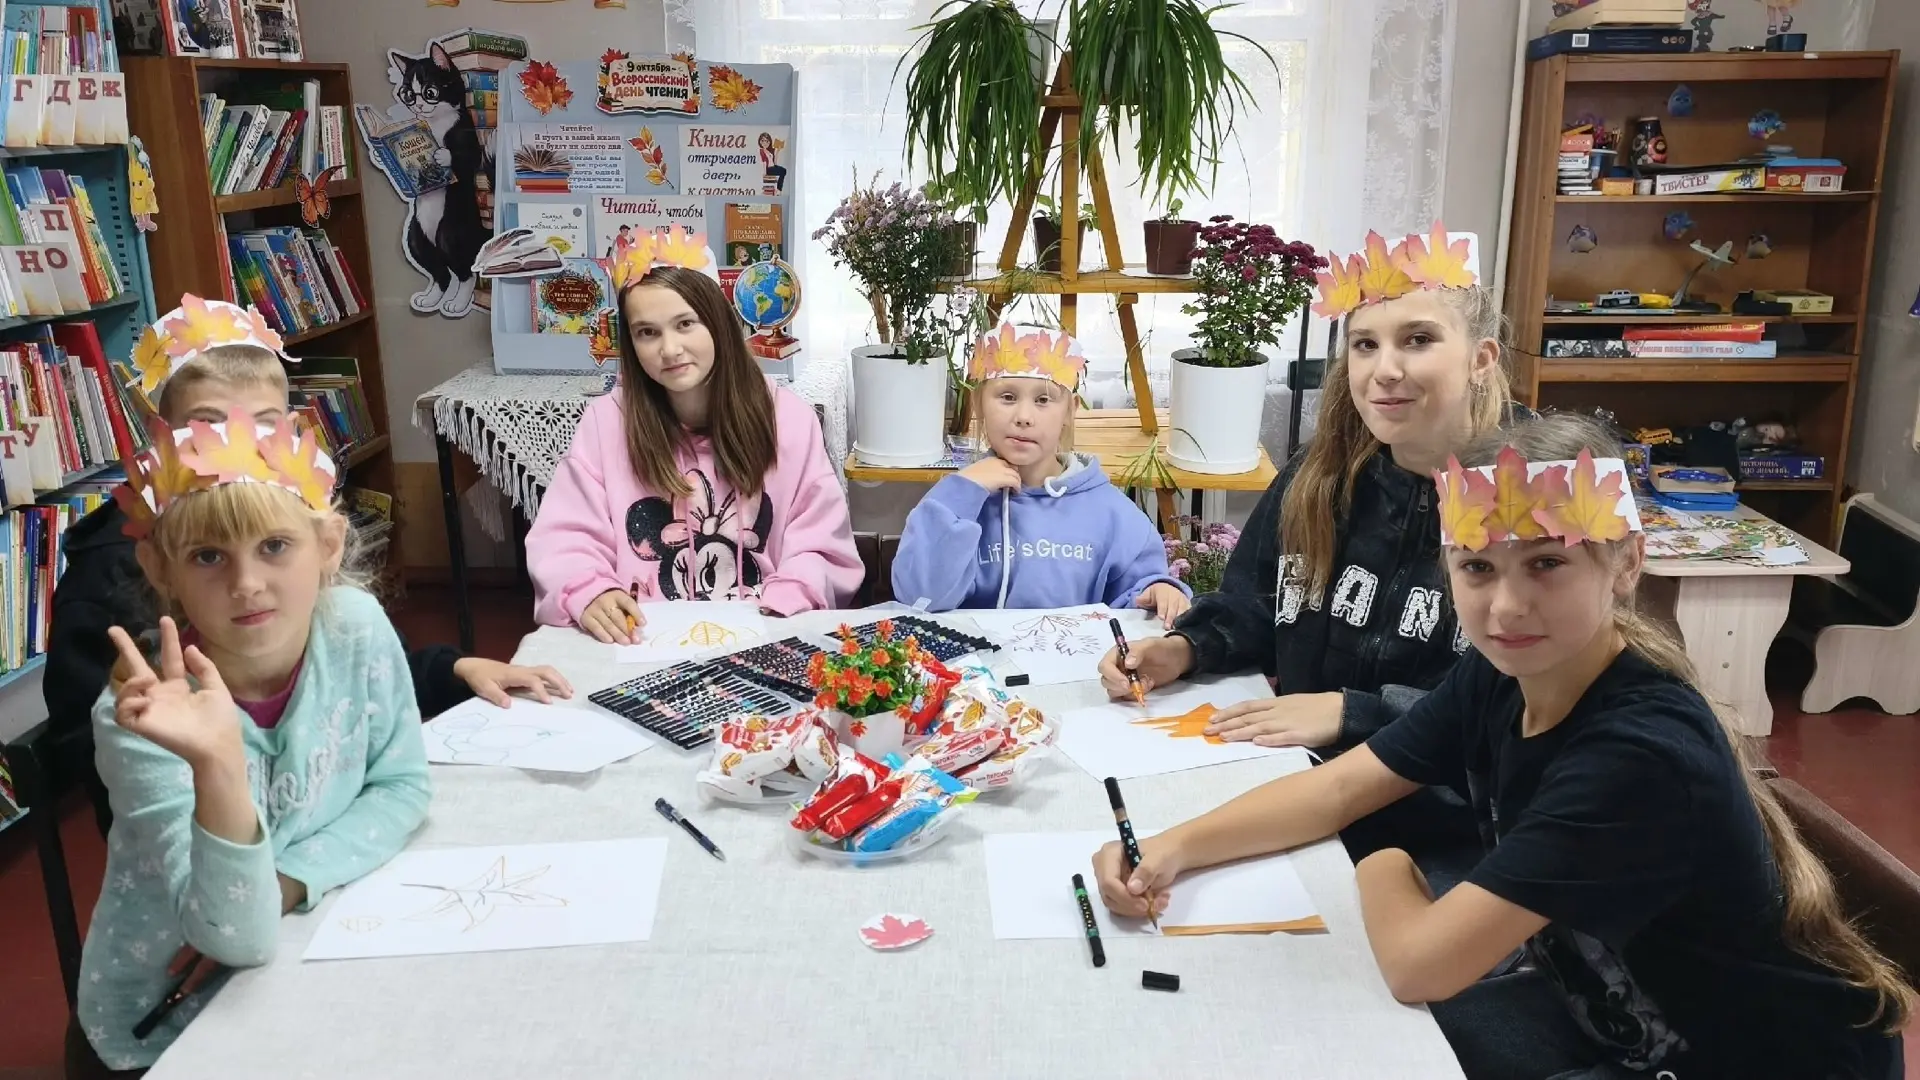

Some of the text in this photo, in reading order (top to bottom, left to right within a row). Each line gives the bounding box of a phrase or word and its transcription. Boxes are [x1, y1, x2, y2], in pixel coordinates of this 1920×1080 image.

[626, 61, 635, 72] 9
[636, 62, 671, 74] октября
[78, 77, 98, 100] Е
[611, 71, 689, 87] Всероссийский
[13, 79, 33, 102] Г
[46, 80, 72, 106] Д
[614, 86, 689, 100] день чтения
[687, 128, 747, 149] Книга
[687, 154, 757, 167] открывает
[702, 168, 741, 183] дверь
[1660, 174, 1710, 193] ТВИСТЕР
[687, 187, 756, 196] к счастью
[600, 197, 704, 218] Читай, чтобы
[40, 209, 69, 231] П
[15, 250, 45, 273] Н
[0, 434, 18, 459] Т
